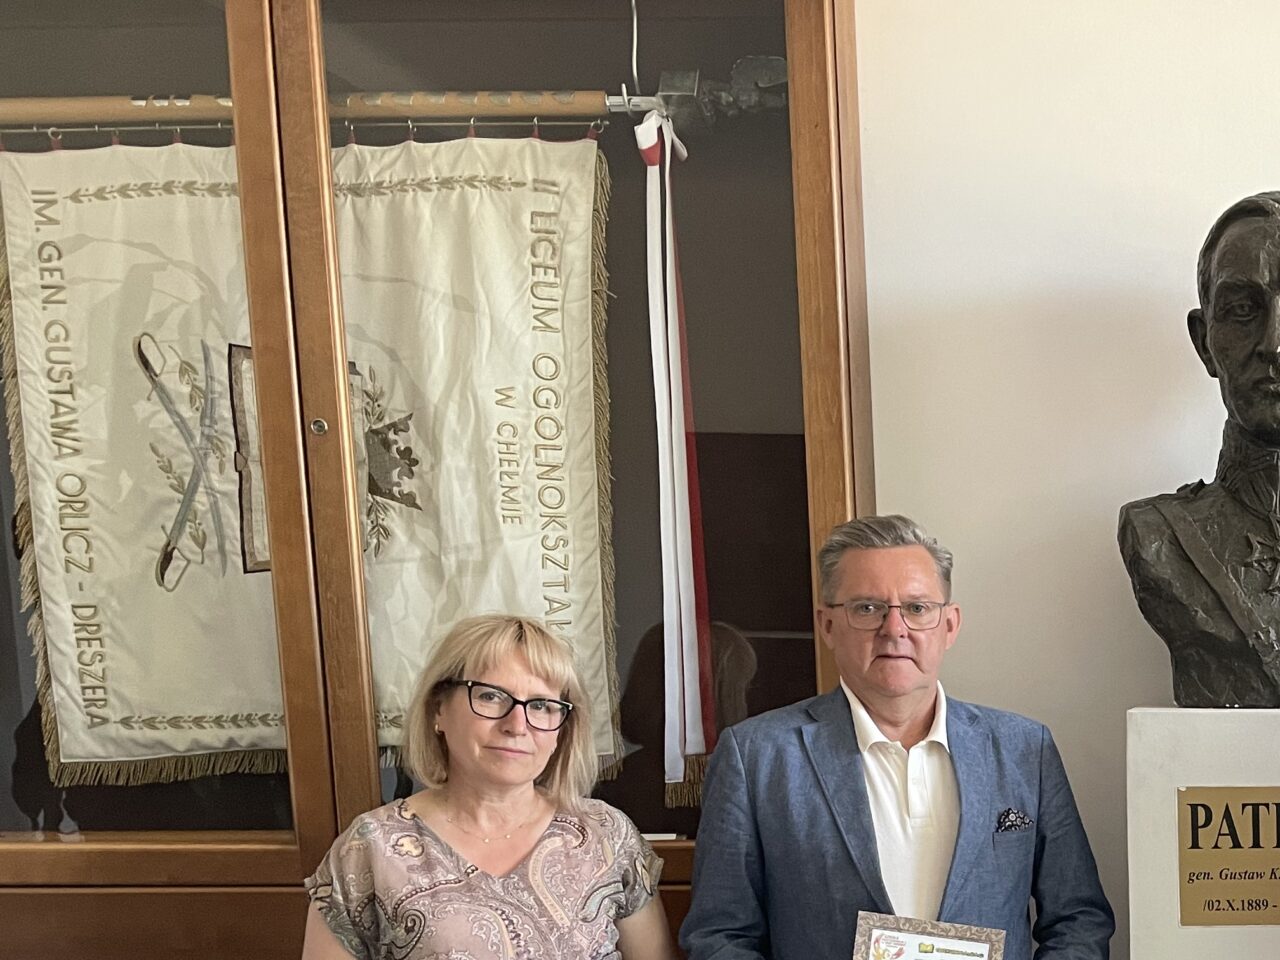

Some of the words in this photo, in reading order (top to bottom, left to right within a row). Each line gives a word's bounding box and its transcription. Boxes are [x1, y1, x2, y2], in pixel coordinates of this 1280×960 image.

[31, 189, 60, 233] IM.
[37, 240, 67, 311] GEN.
[530, 211, 561, 333] LICEUM
[44, 319, 83, 459] GUSTAWA
[494, 386, 516, 409] W
[56, 471, 94, 574] ORLICZ
[496, 421, 523, 526] CHEŁMIE
[532, 353, 575, 650] OGÓLNOKSZTAŁ
[71, 604, 110, 729] DRESZERA
[1187, 870, 1214, 884] gen.
[1219, 867, 1266, 881] Gustaw
[1202, 898, 1269, 912] /02.X.1889
